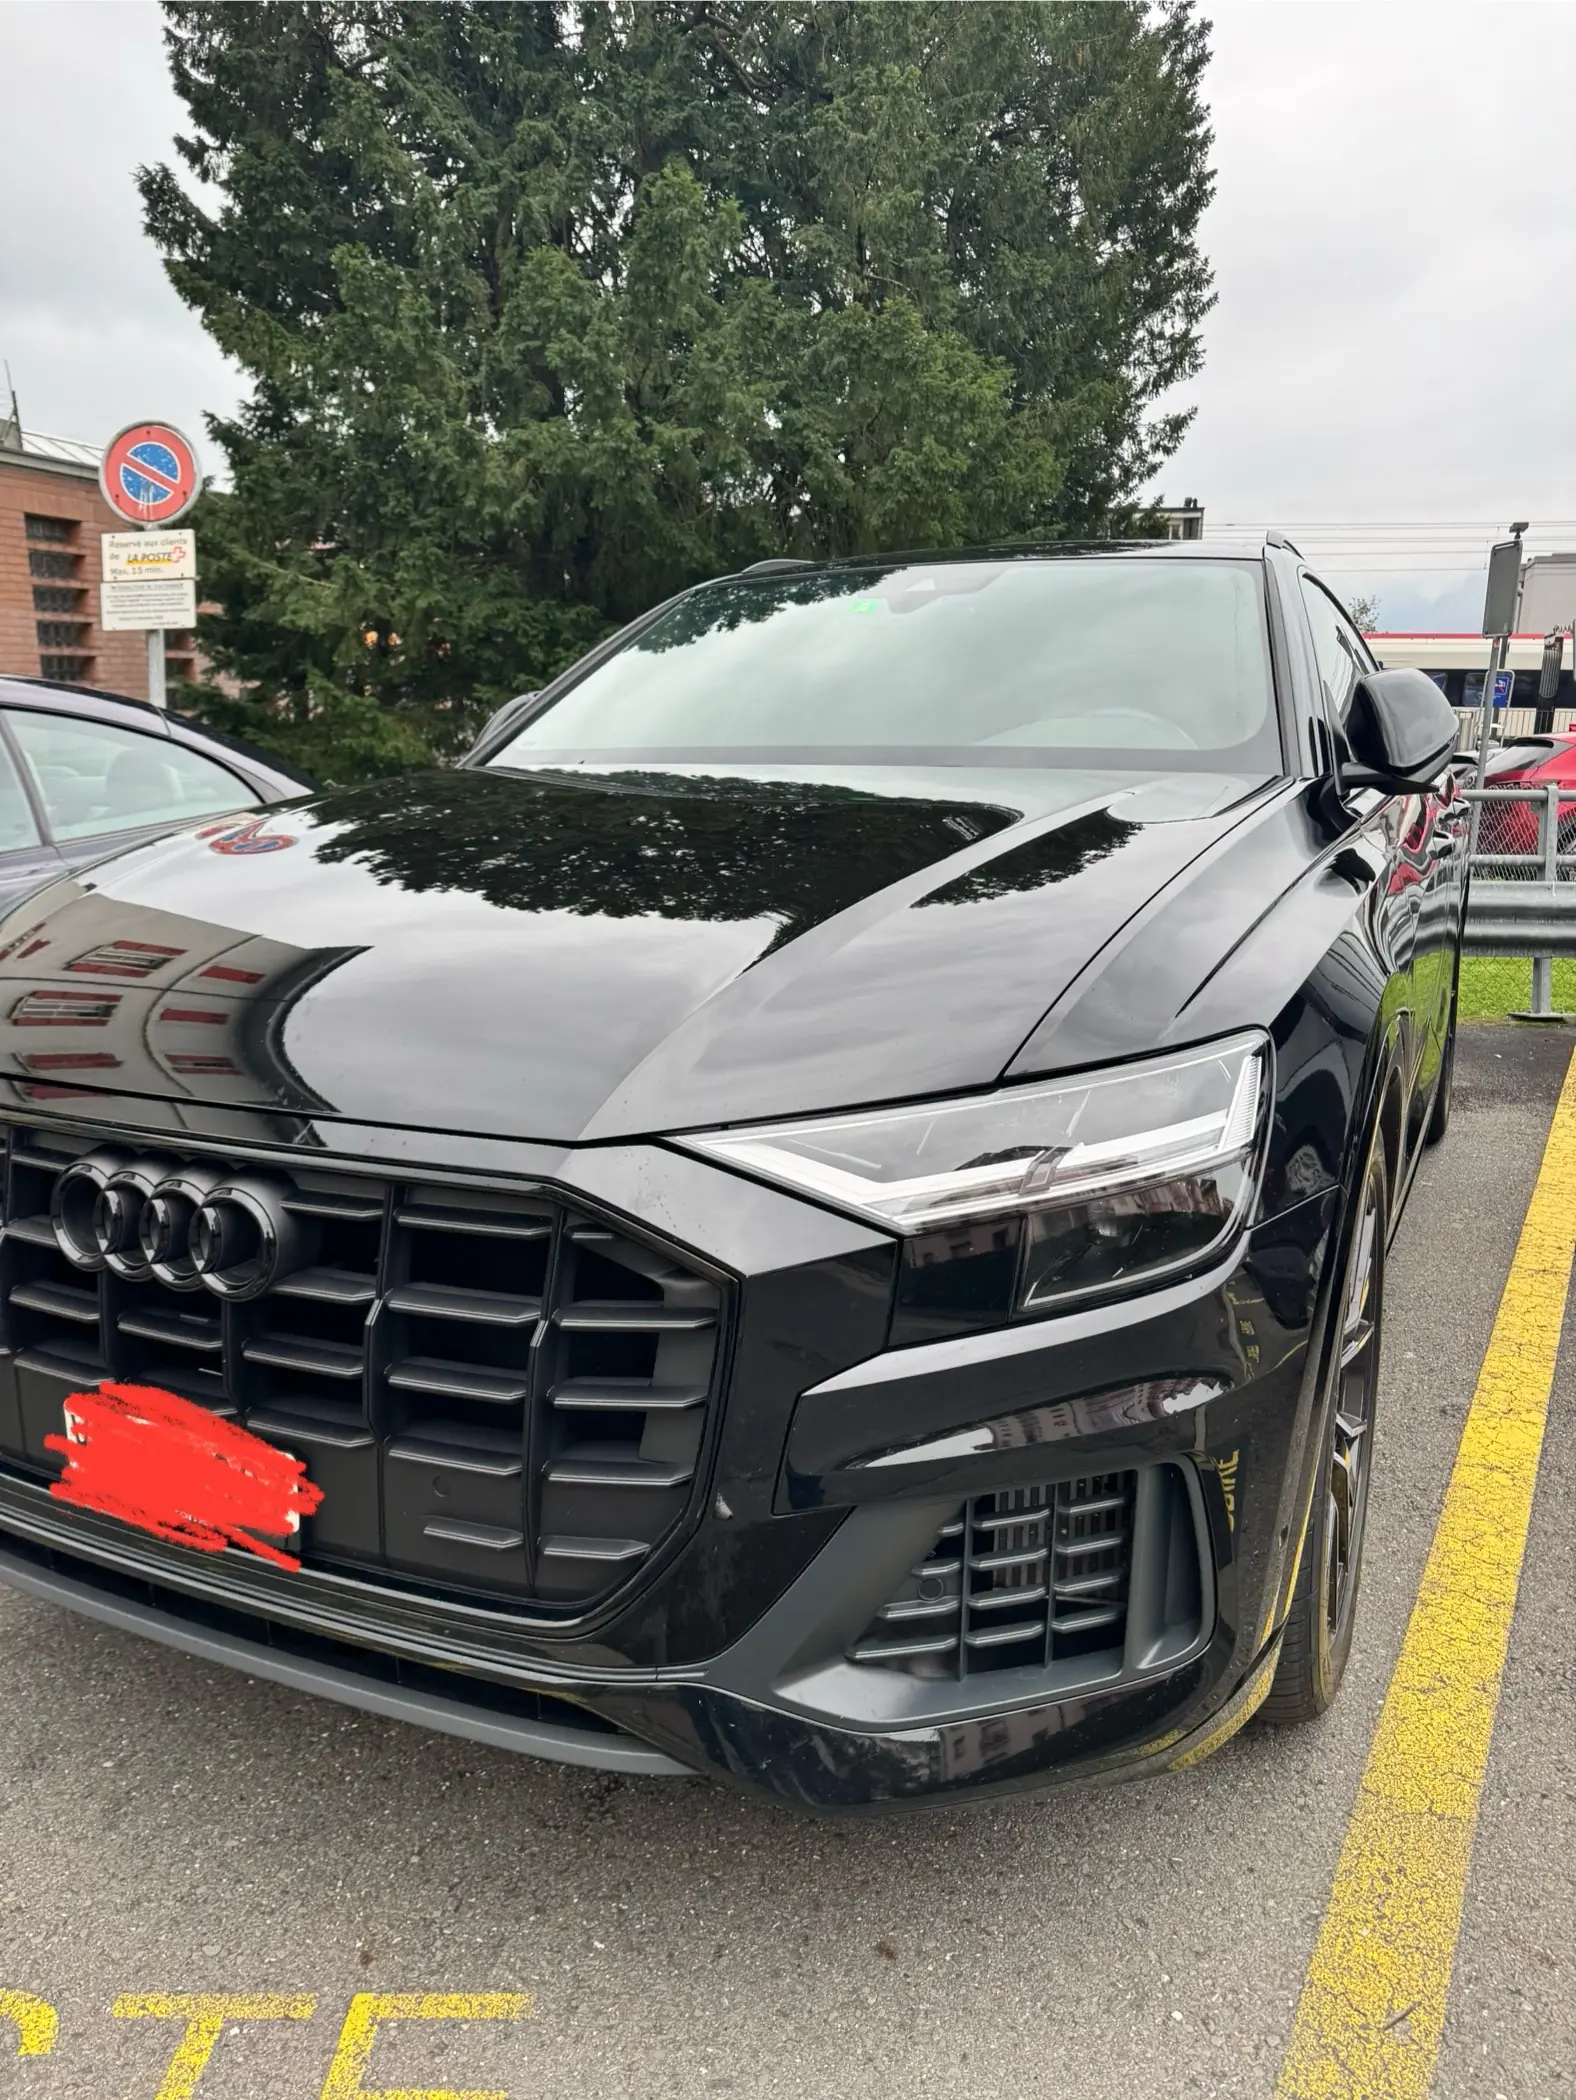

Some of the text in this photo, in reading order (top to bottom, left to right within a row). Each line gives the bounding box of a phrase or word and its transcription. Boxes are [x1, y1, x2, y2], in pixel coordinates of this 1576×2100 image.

[144, 540, 158, 548] aux
[160, 538, 187, 546] clients
[127, 553, 139, 563] LA
[141, 552, 173, 562] POSTE
[131, 567, 143, 575] 15
